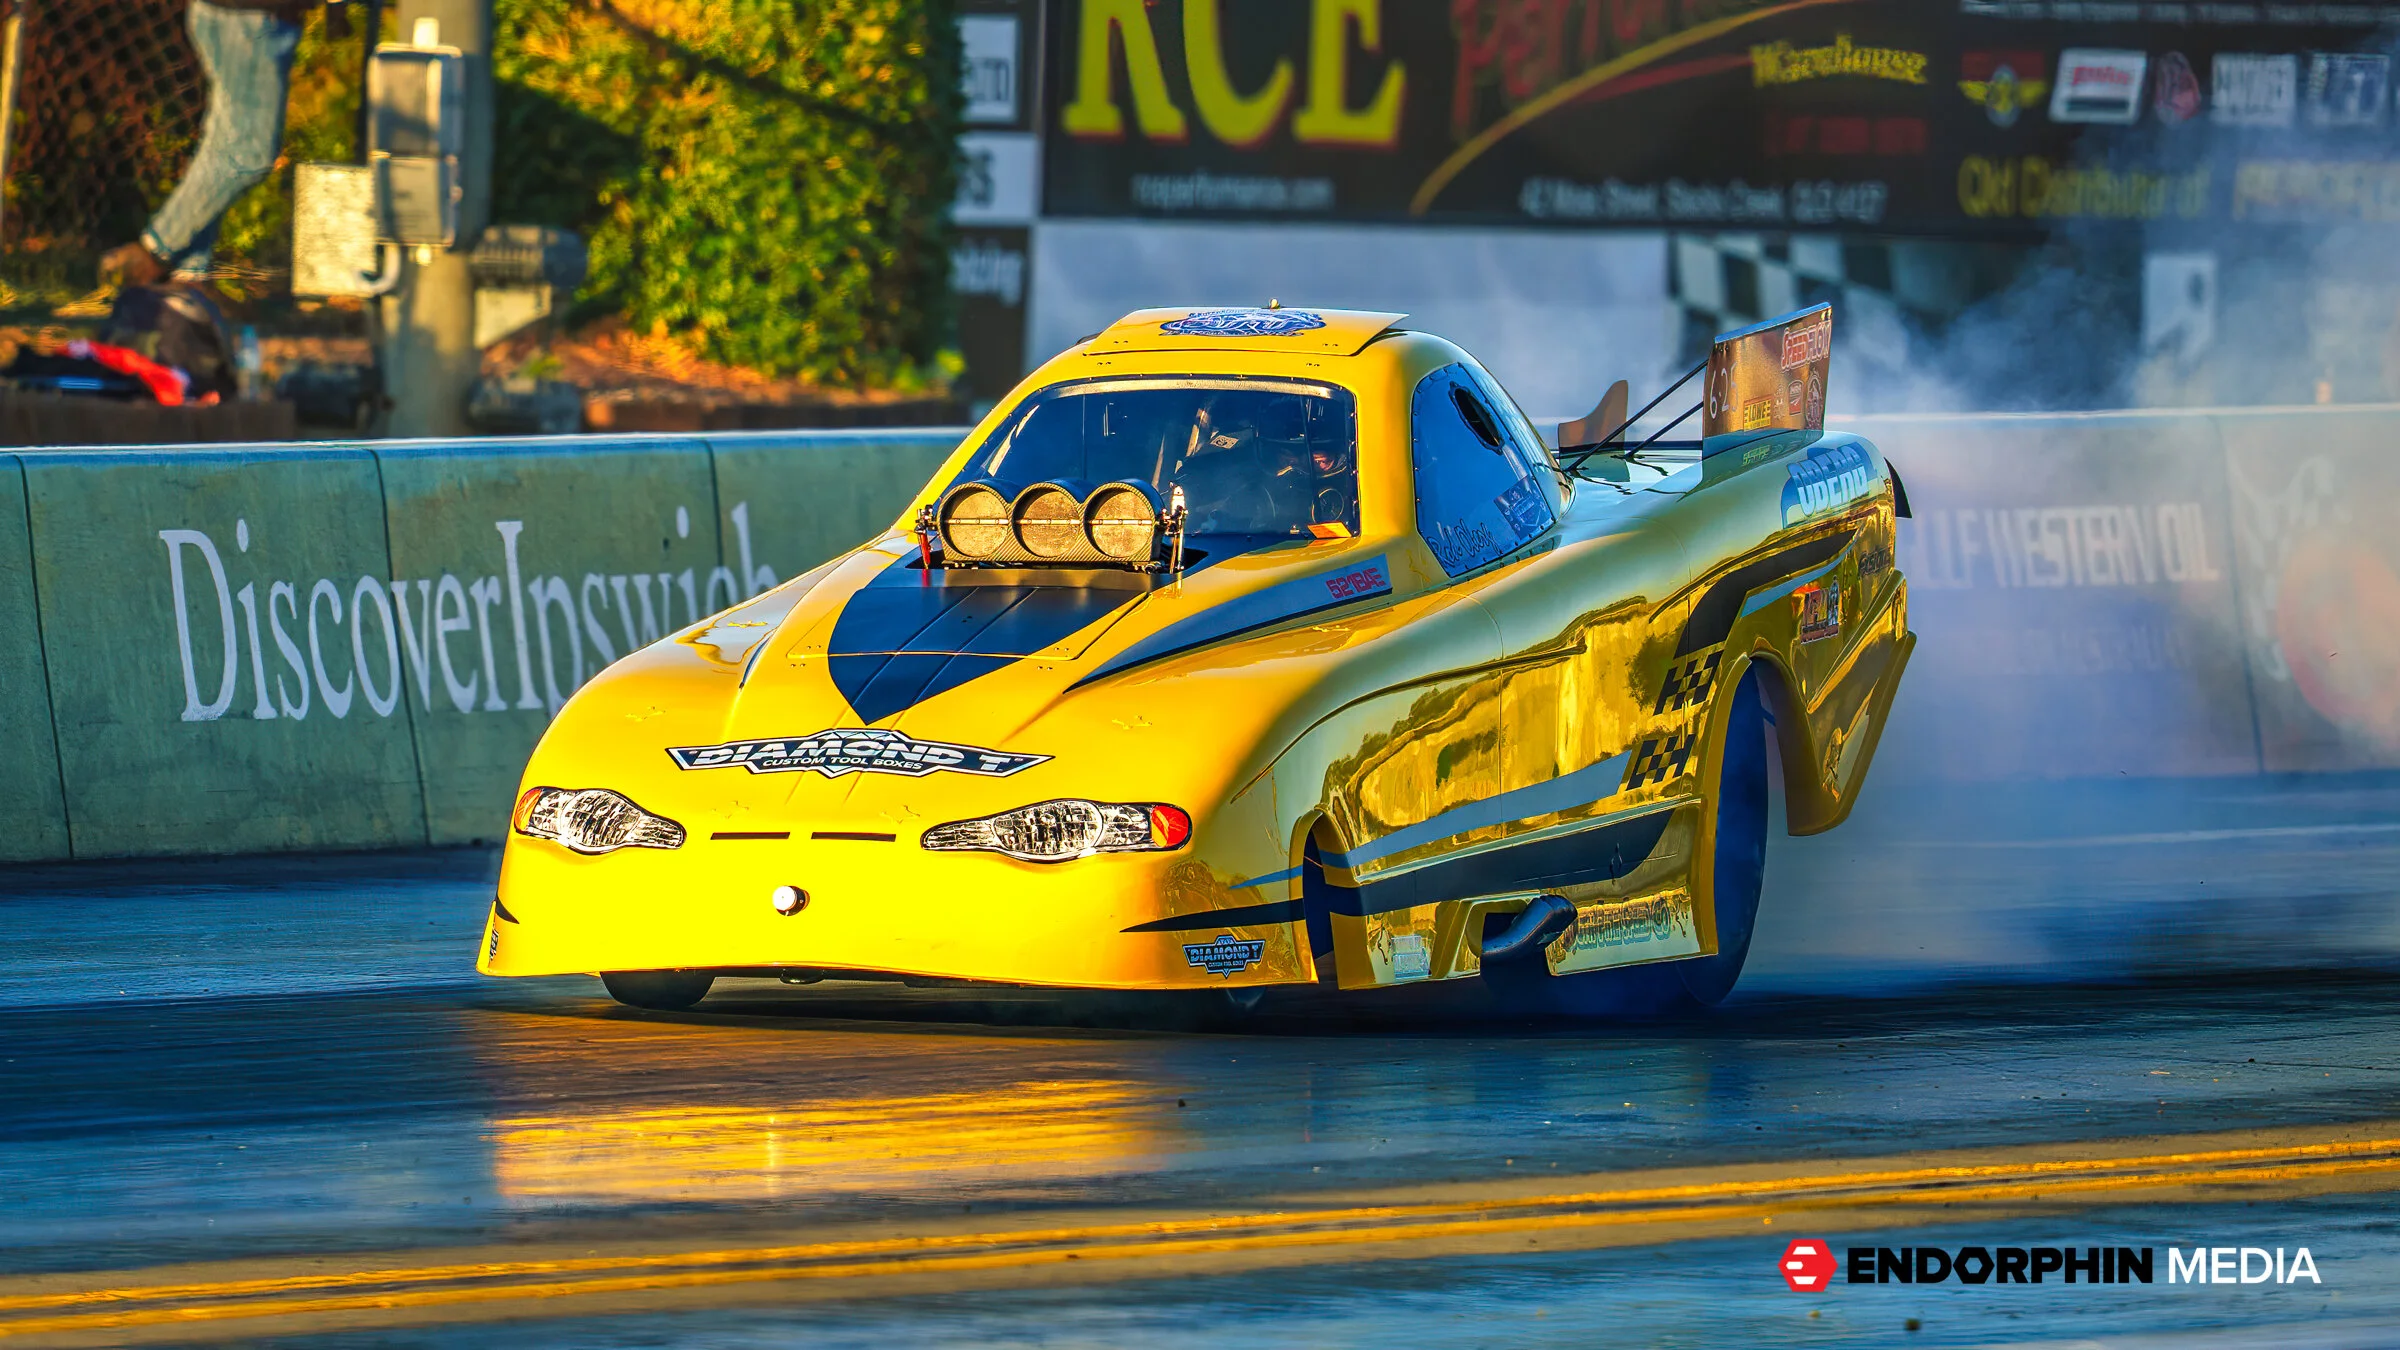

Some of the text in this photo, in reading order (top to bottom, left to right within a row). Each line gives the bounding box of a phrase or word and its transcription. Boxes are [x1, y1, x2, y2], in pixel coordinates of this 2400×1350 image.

[1985, 505, 2157, 589] WESTERN
[2159, 502, 2220, 583] OIL
[693, 740, 1011, 771] DIAMOND T
[762, 756, 923, 770] CUSTOM TOOL BOXES
[1190, 945, 1250, 962] DIAMOND
